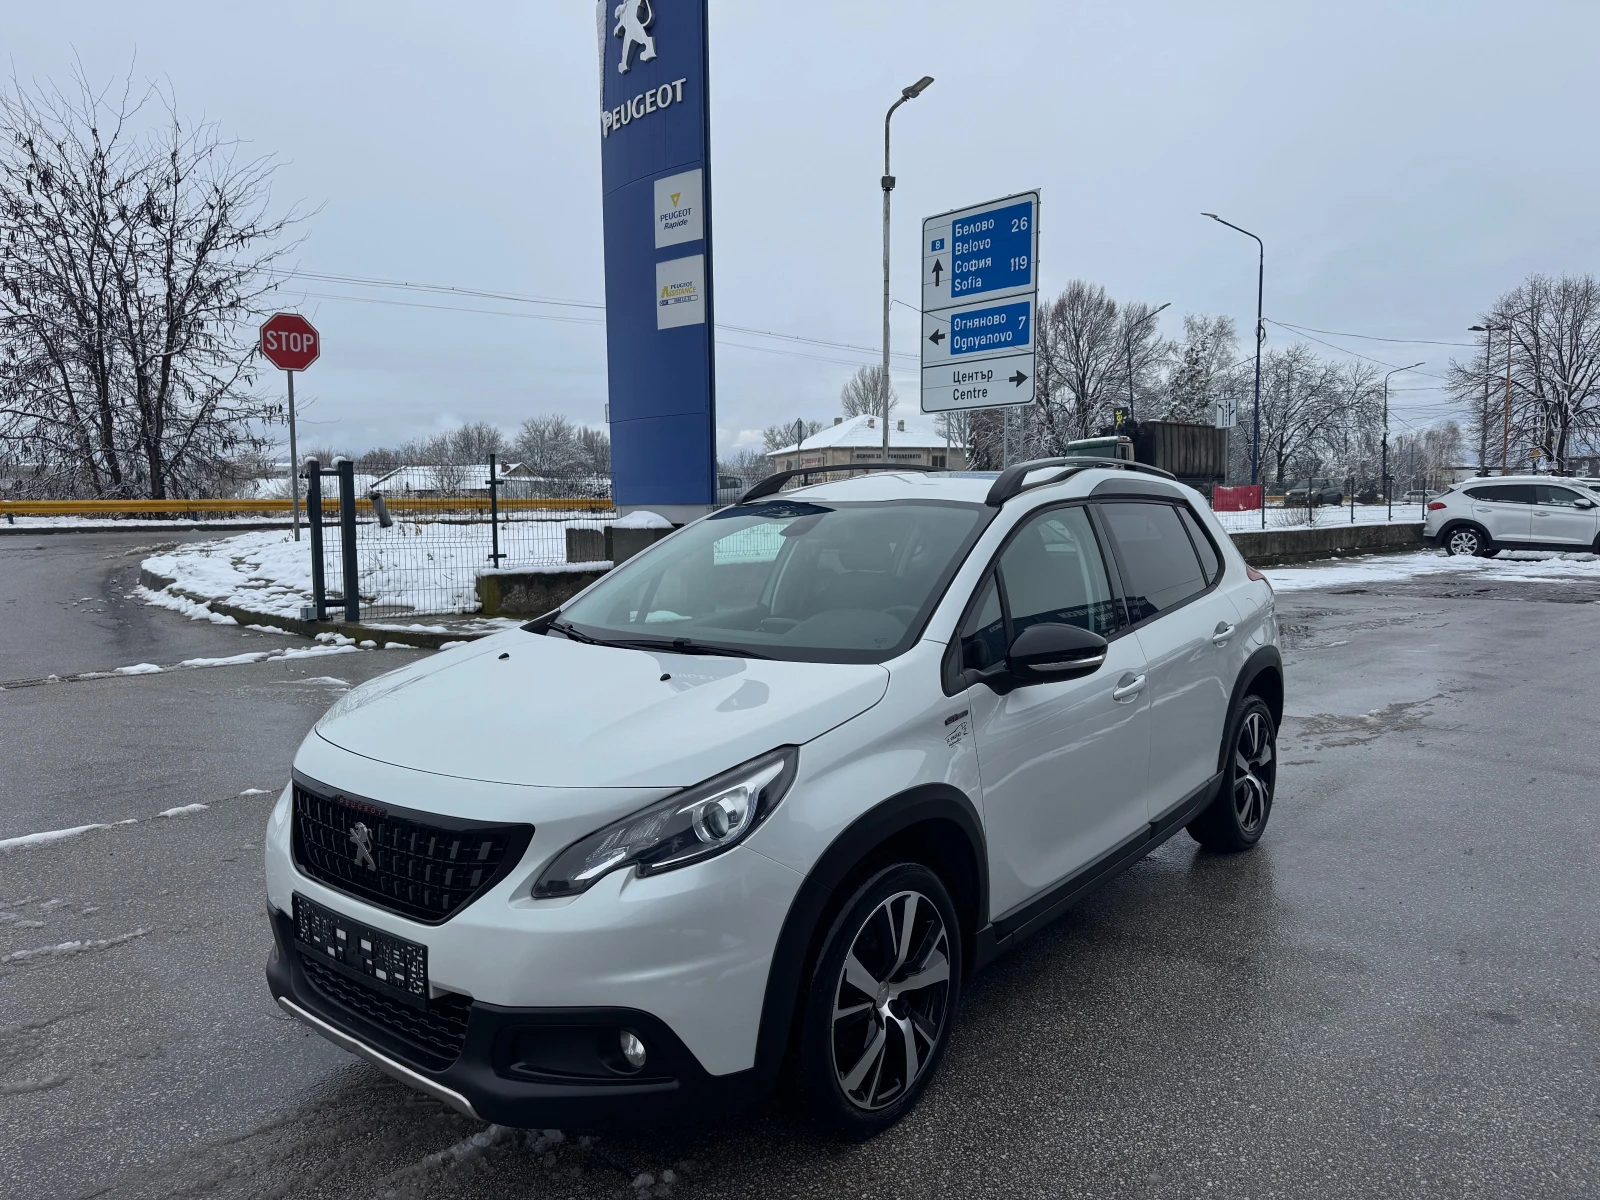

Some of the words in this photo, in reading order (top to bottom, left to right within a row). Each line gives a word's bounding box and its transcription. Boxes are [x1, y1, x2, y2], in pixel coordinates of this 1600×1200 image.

[602, 78, 686, 138] PEUGEOT
[660, 208, 692, 222] PEUGEOT
[663, 219, 688, 230] Rapide
[955, 219, 995, 237] Белово
[1011, 216, 1028, 233] 26
[955, 238, 991, 255] Belovo
[955, 257, 992, 274] София
[1010, 255, 1028, 272] 119
[954, 276, 982, 292] Sofia
[954, 313, 1007, 331] Огняново
[1018, 316, 1026, 330] 7
[266, 330, 314, 353] STOP
[953, 331, 1013, 351] Ognyanovo
[953, 369, 993, 385] Център
[953, 387, 988, 401] Centre
